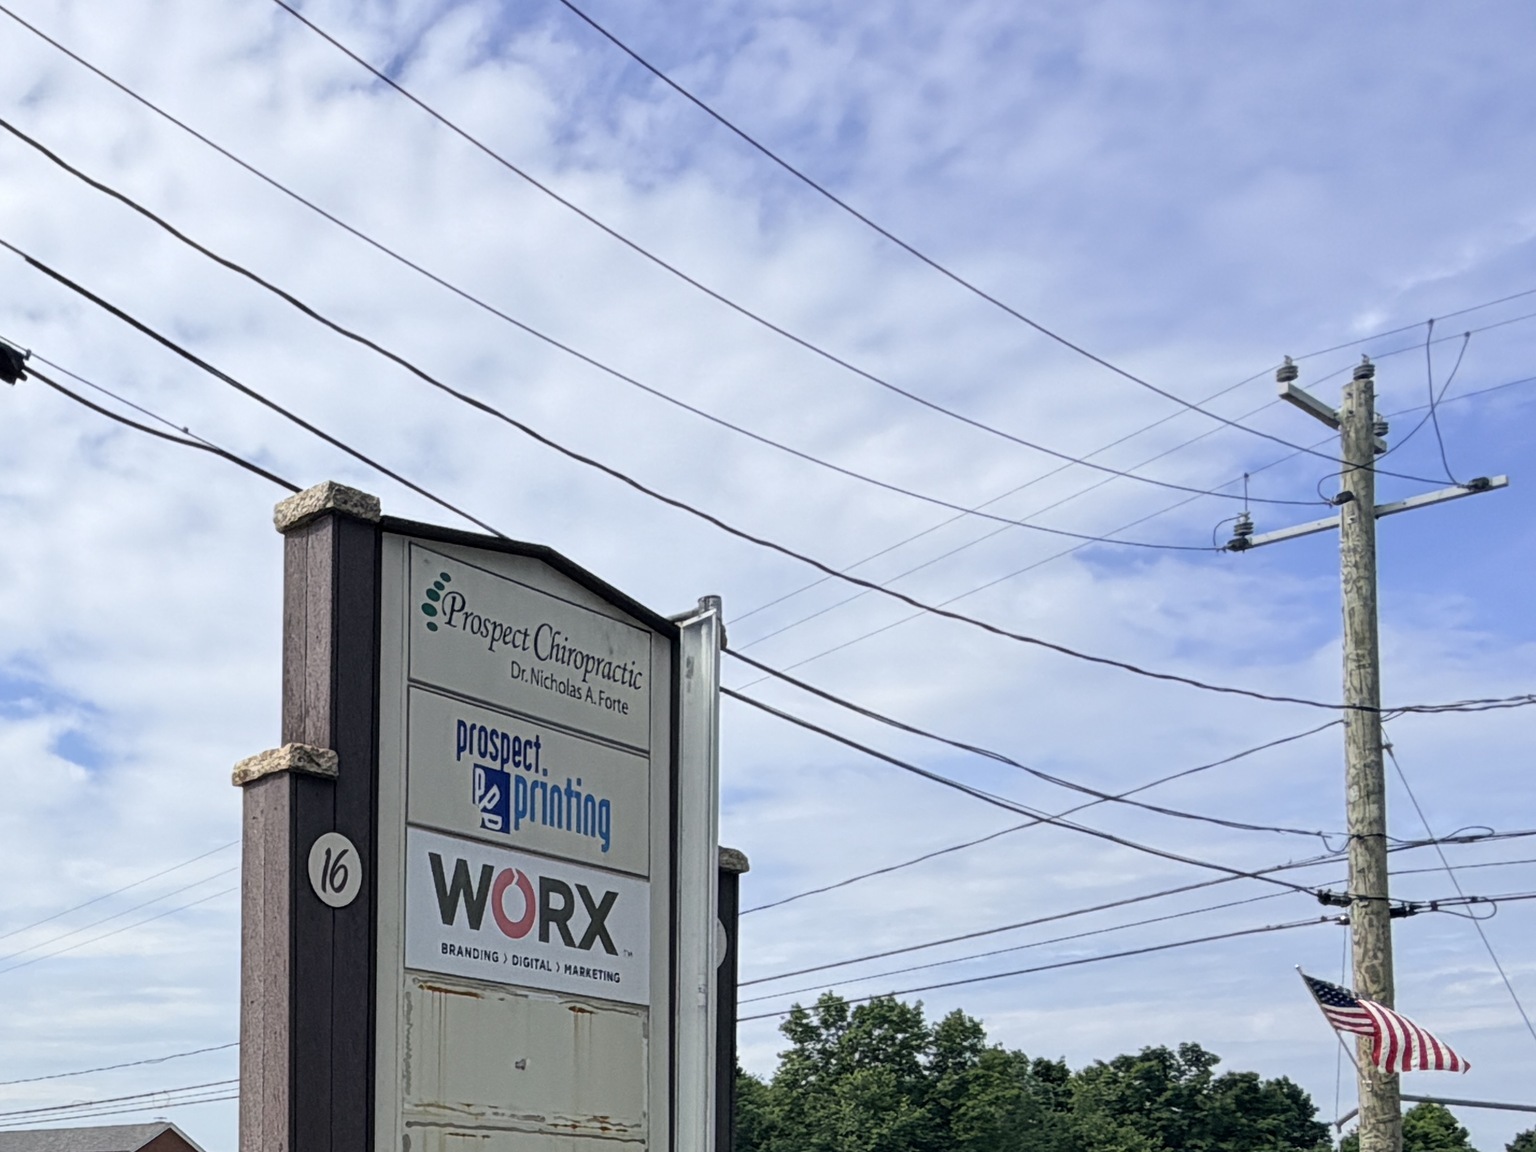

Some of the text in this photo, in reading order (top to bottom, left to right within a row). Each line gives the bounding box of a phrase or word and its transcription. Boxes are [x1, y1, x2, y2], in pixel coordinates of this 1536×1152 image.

[441, 590, 643, 690] Prospect Chiropractic
[510, 660, 629, 715] Dr. Nicholas A. Forte
[456, 718, 541, 775] prospect
[514, 768, 611, 853] printing
[321, 847, 349, 895] 16
[427, 851, 619, 956] WORX
[441, 942, 621, 983] BRANDING DIGITAL MARKETING
